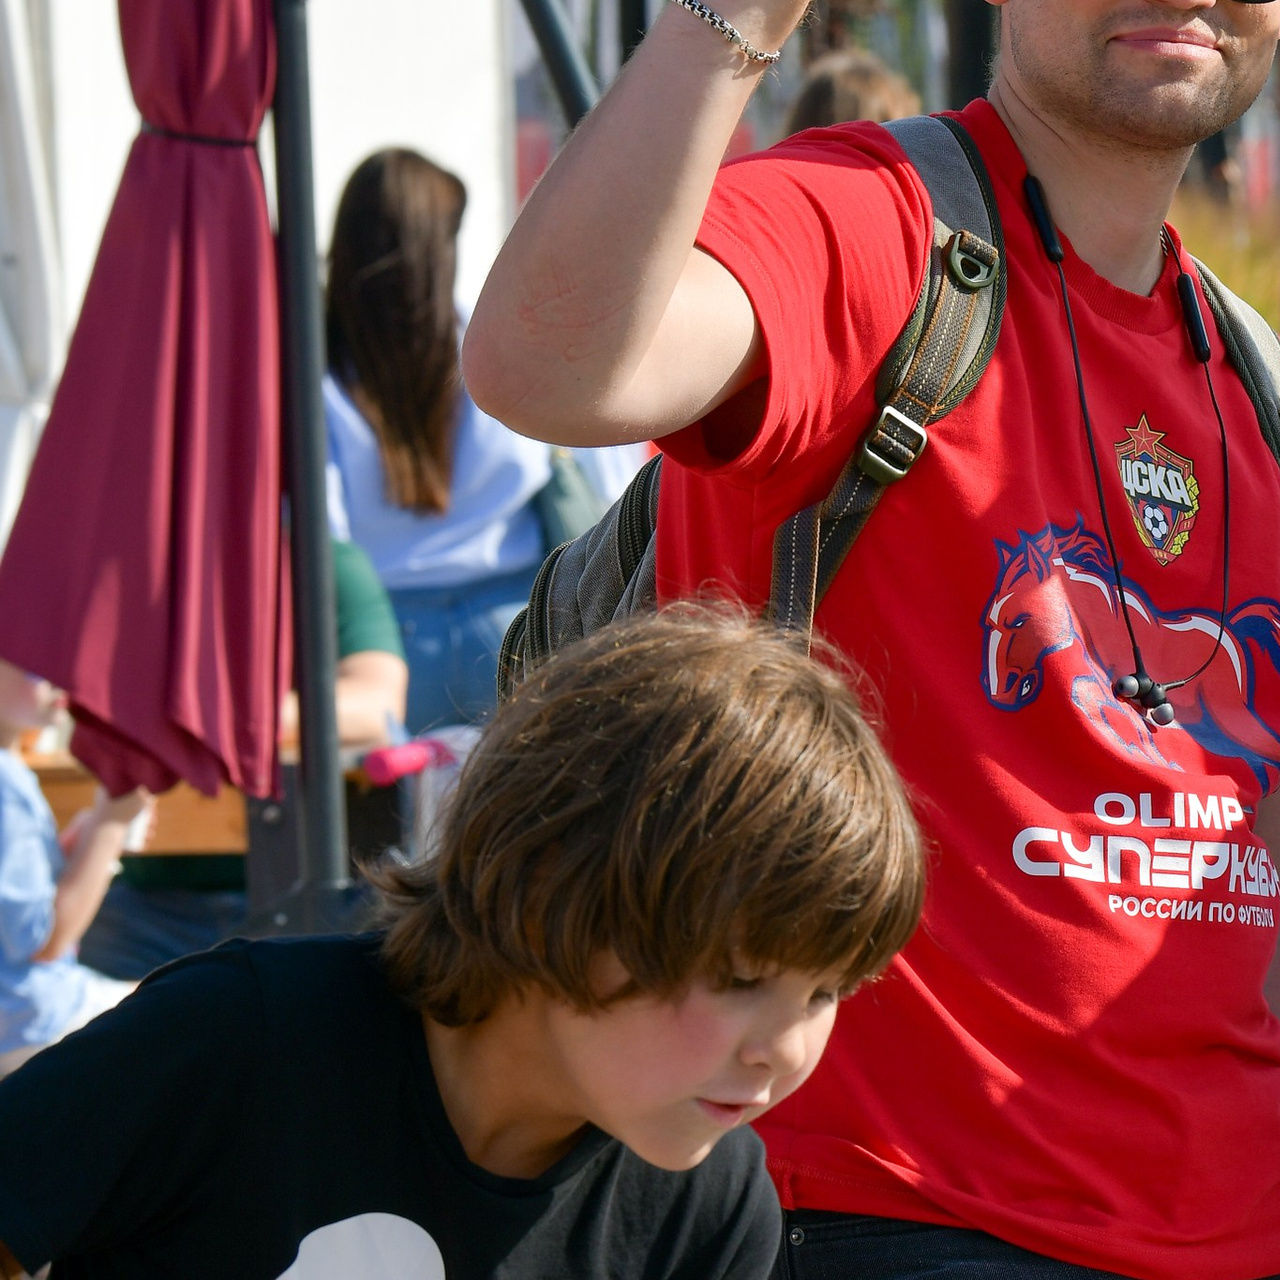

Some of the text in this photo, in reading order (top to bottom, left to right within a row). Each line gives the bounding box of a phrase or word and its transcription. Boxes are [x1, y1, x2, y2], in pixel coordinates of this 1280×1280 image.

[1121, 458, 1193, 507] ЦСКА
[1093, 792, 1245, 831] OLIMP
[1108, 894, 1202, 921] РОССИИ
[1208, 901, 1235, 923] ПО
